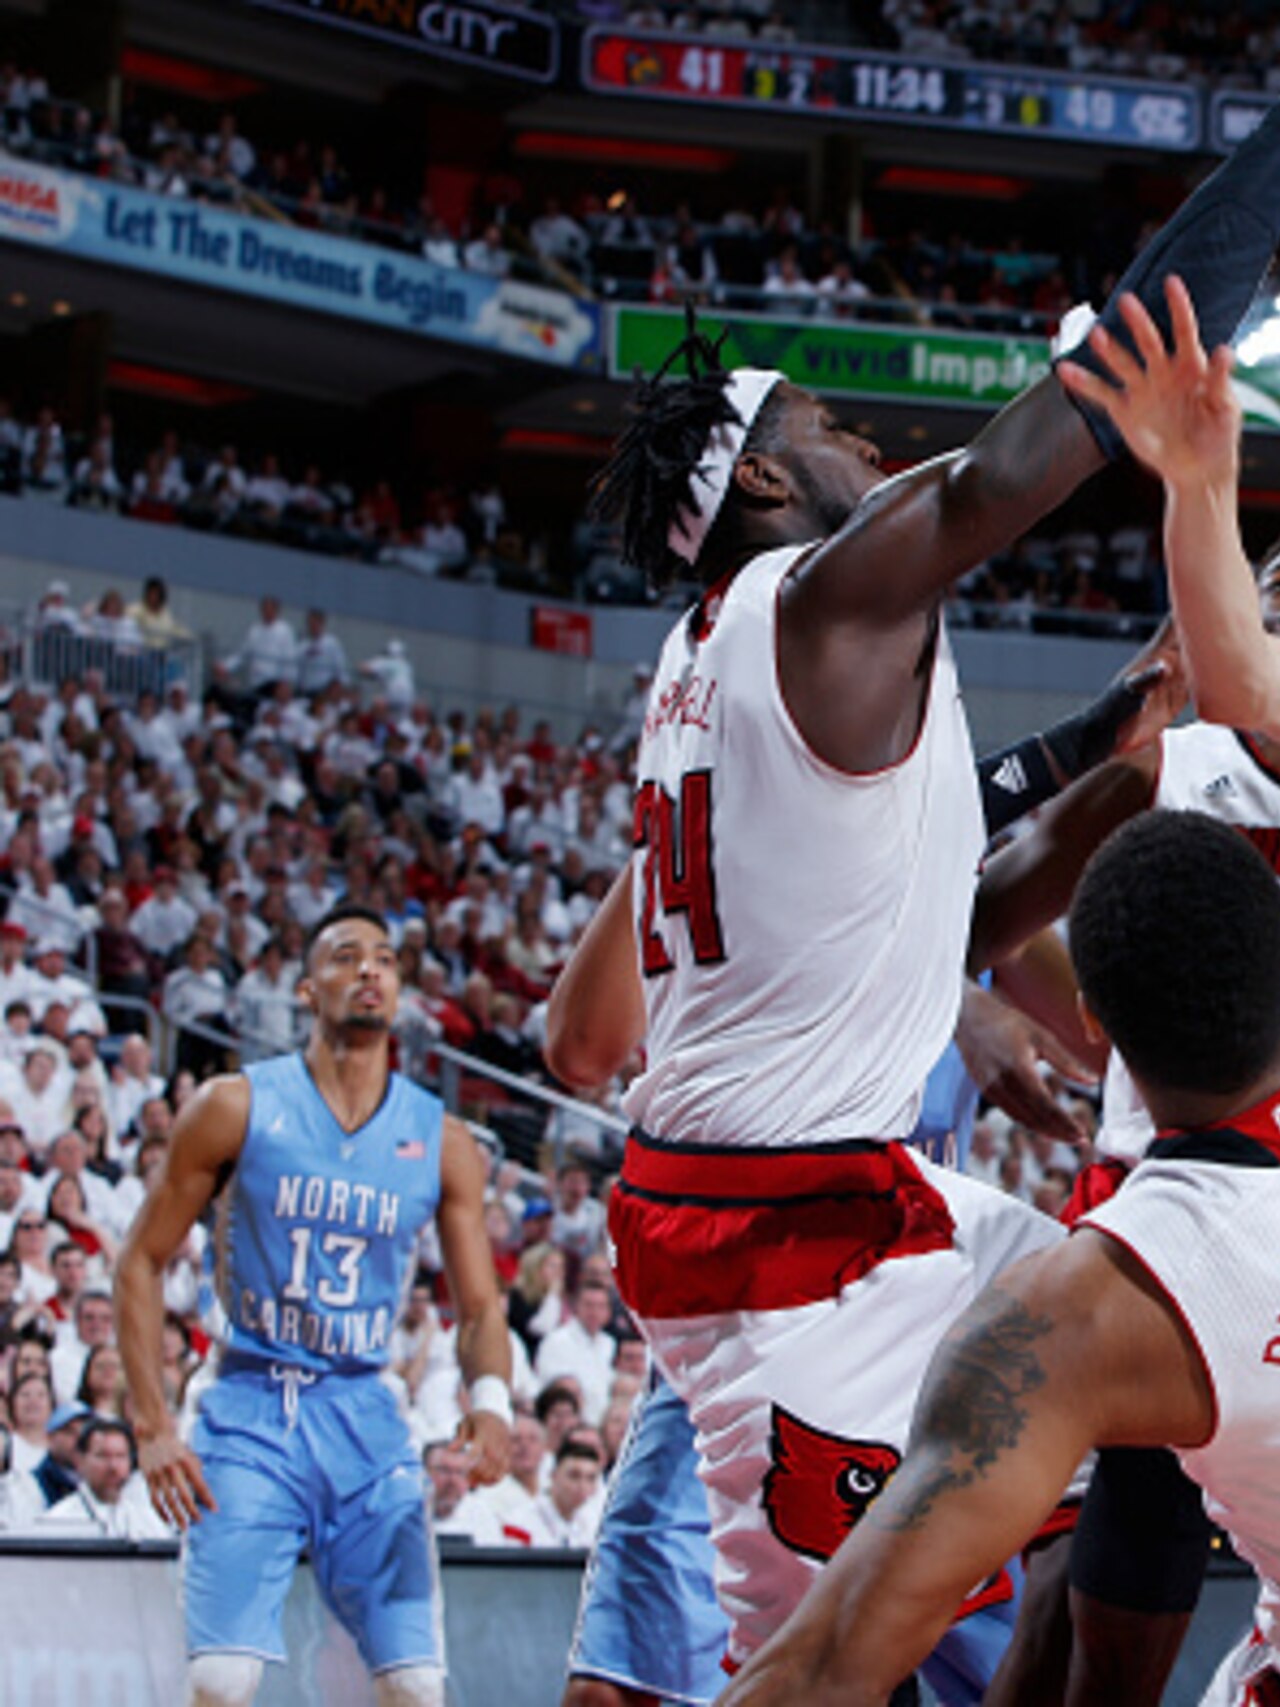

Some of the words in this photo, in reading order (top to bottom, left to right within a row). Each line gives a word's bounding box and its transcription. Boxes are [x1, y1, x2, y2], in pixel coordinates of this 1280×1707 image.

[417, 2, 519, 56] CITY
[678, 47, 724, 92] 41
[105, 198, 157, 247] Let
[166, 210, 229, 264] The
[237, 228, 362, 297] Dreams
[374, 261, 466, 324] Begin
[633, 768, 727, 978] 24
[275, 1175, 399, 1237] NORTH
[282, 1226, 368, 1307] 13
[241, 1287, 388, 1356] CAROLINA
